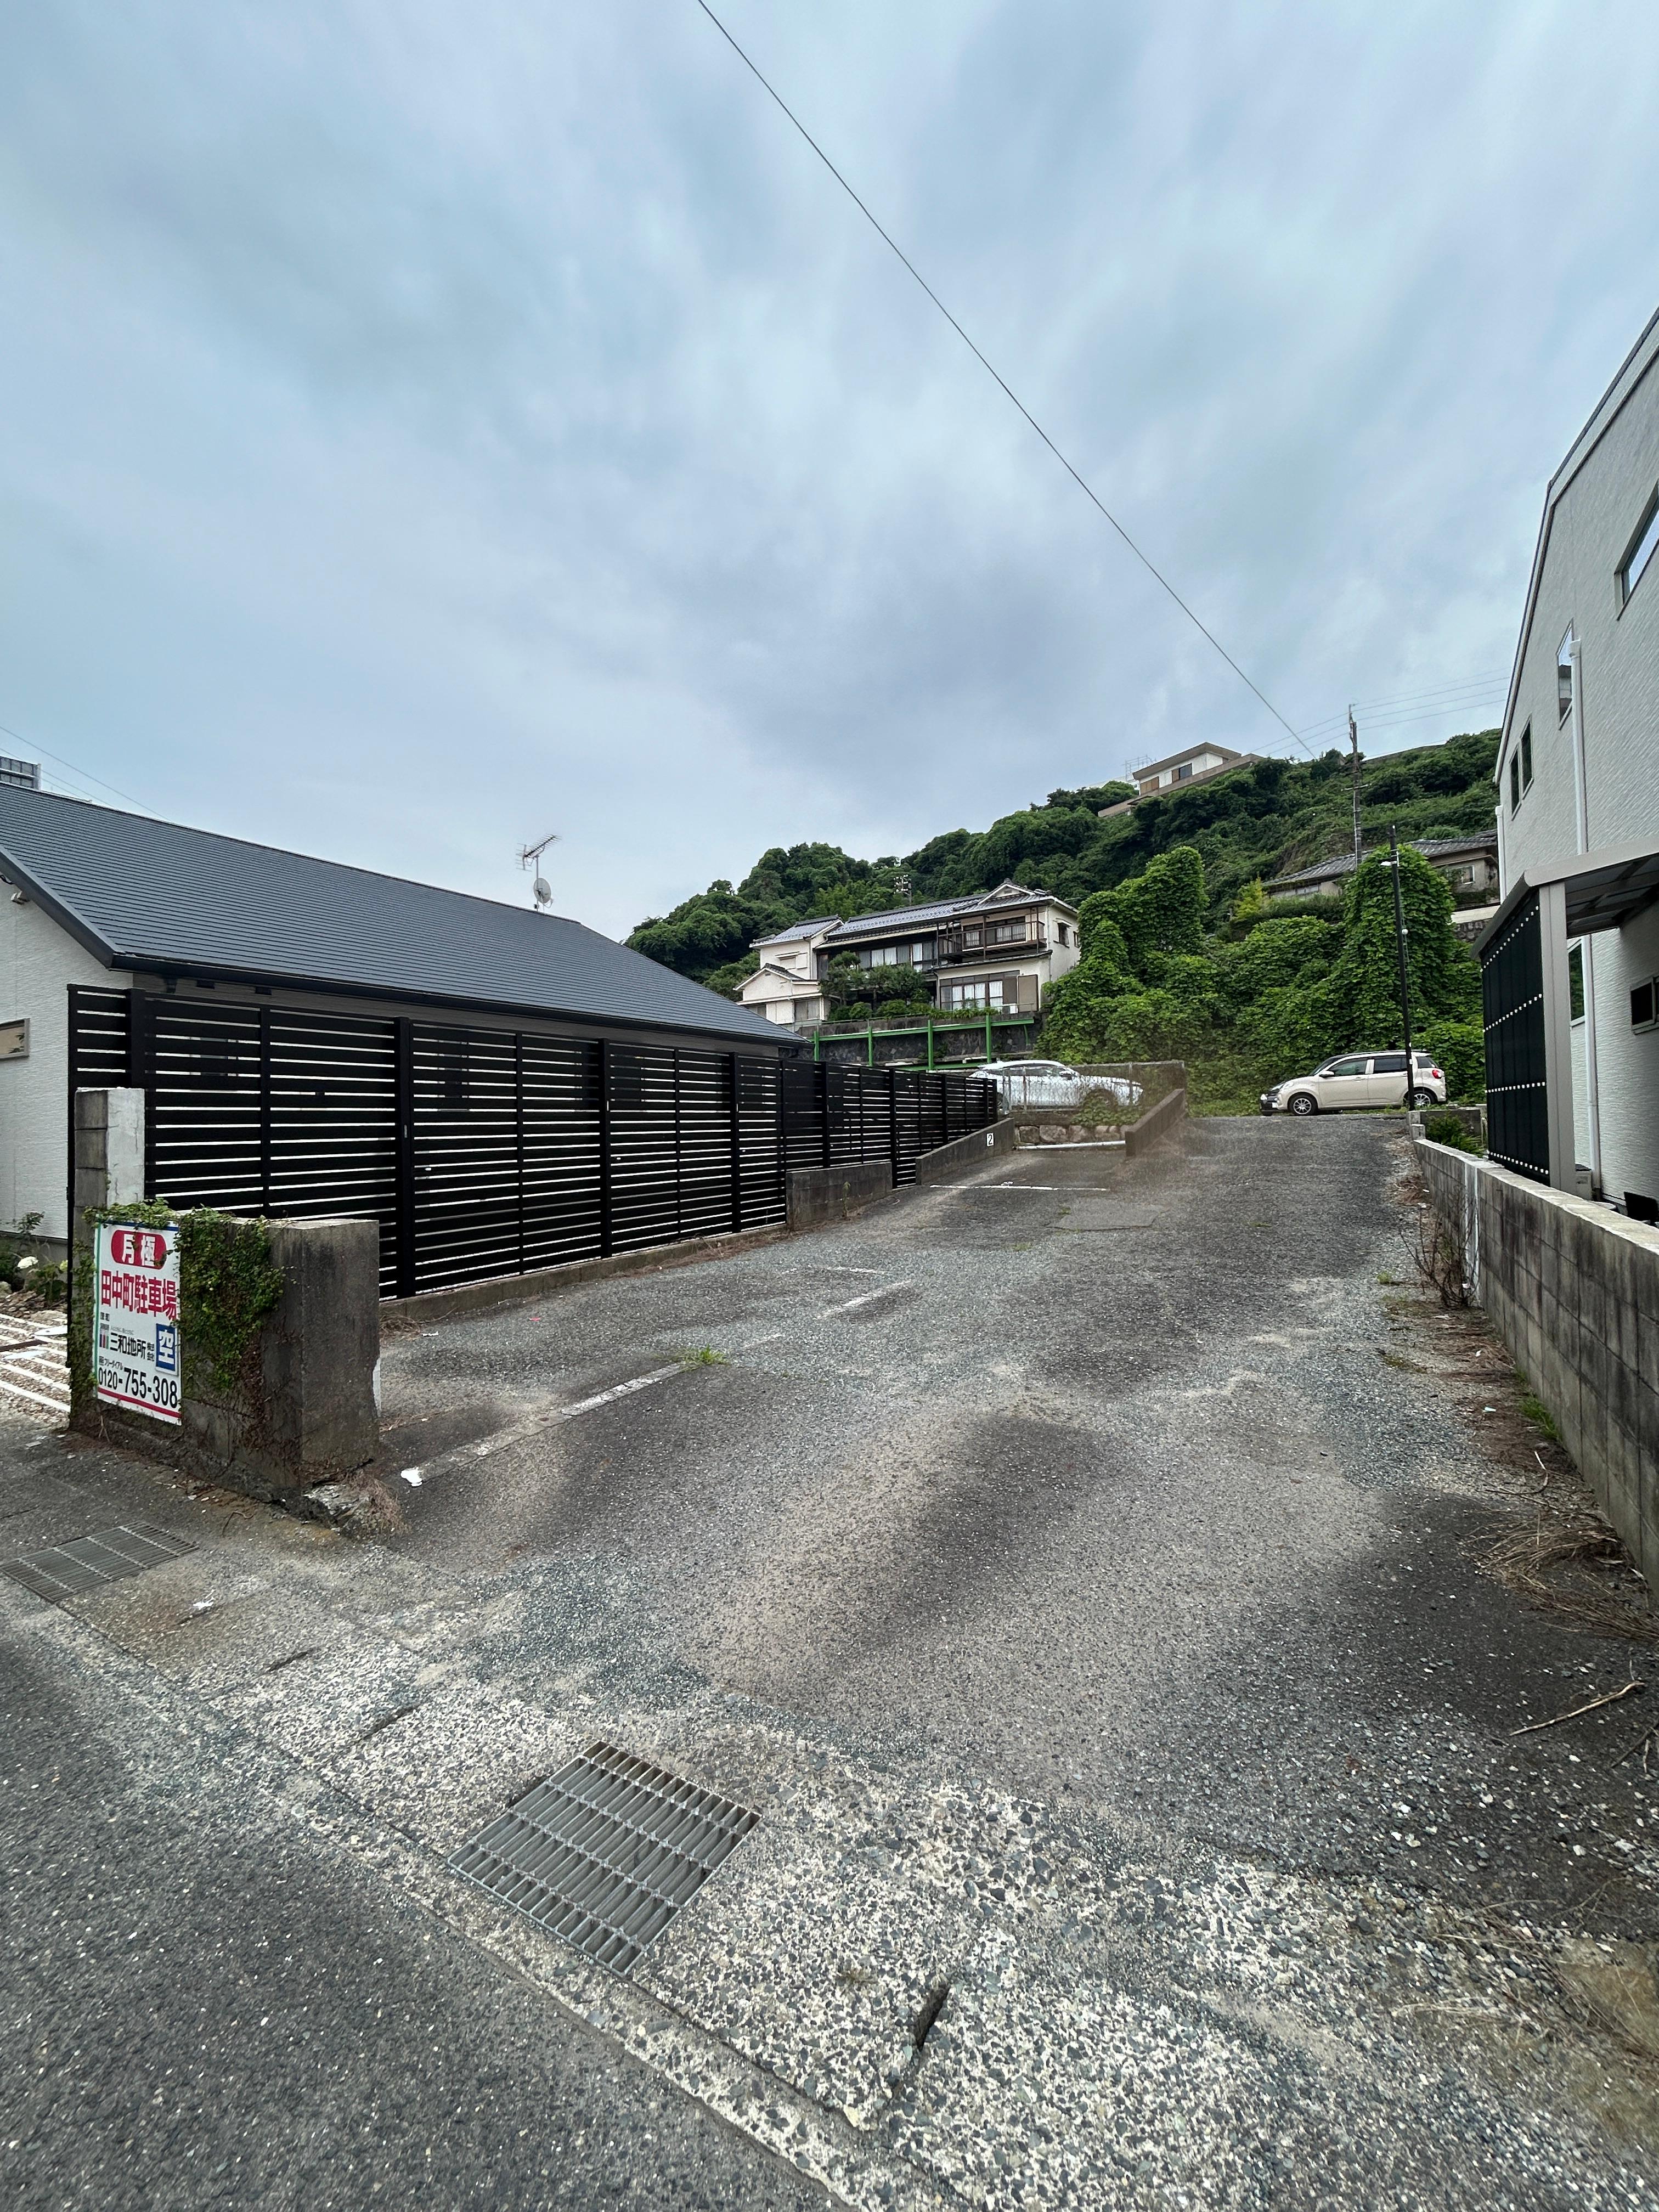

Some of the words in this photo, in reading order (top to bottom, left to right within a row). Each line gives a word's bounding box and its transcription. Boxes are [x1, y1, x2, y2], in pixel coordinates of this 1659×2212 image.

[988, 1133, 992, 1145] 2
[122, 1234, 156, 1267] 月極
[101, 1269, 176, 1321] 田中町駐車場
[110, 1332, 146, 1359] 三和地所
[159, 1329, 174, 1364] 空
[99, 1367, 177, 1408] 0120-755-308
